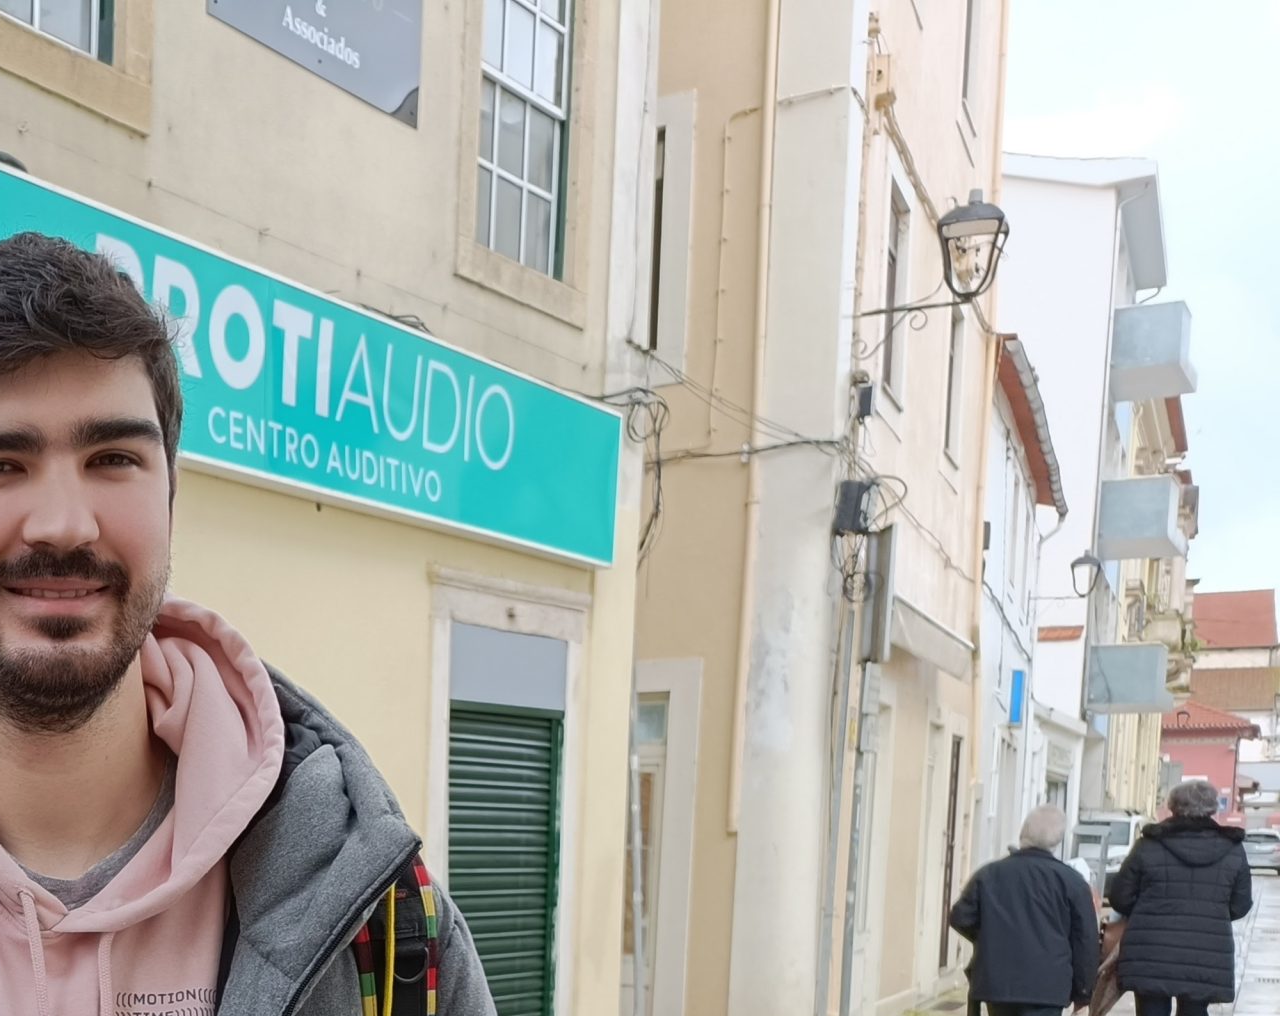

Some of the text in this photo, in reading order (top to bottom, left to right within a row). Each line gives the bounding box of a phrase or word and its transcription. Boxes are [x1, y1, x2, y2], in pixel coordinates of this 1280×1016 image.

[282, 5, 361, 69] Associados
[207, 406, 442, 502] CENTRO AUDITIVO
